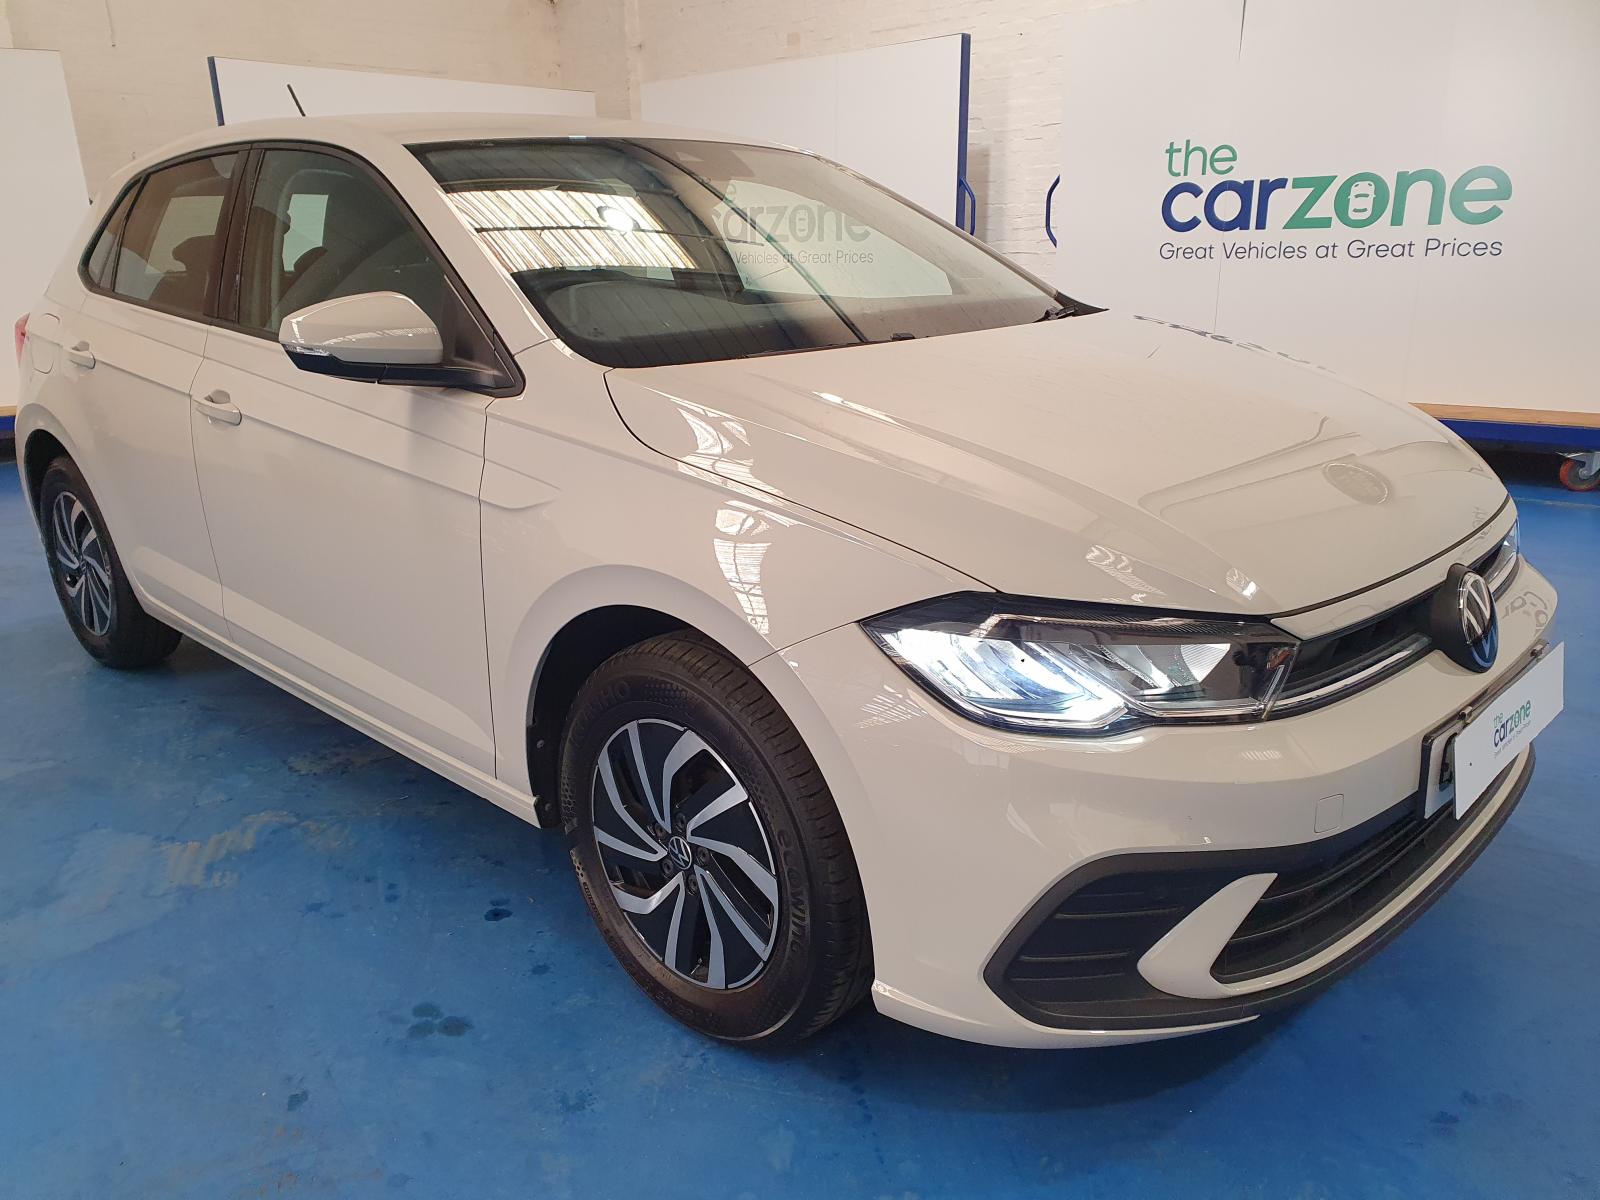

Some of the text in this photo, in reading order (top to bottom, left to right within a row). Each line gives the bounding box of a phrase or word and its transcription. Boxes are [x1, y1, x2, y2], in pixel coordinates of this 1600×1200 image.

[1165, 138, 1238, 177] the
[1161, 165, 1513, 233] carzone
[711, 203, 871, 243] arzone
[735, 250, 779, 264] Vehicles
[797, 250, 832, 264] Great
[835, 249, 875, 264] Prices
[1159, 237, 1503, 260] Great Vehicles at Great Prices
[1493, 712, 1504, 728] the
[1493, 699, 1532, 748] carzone
